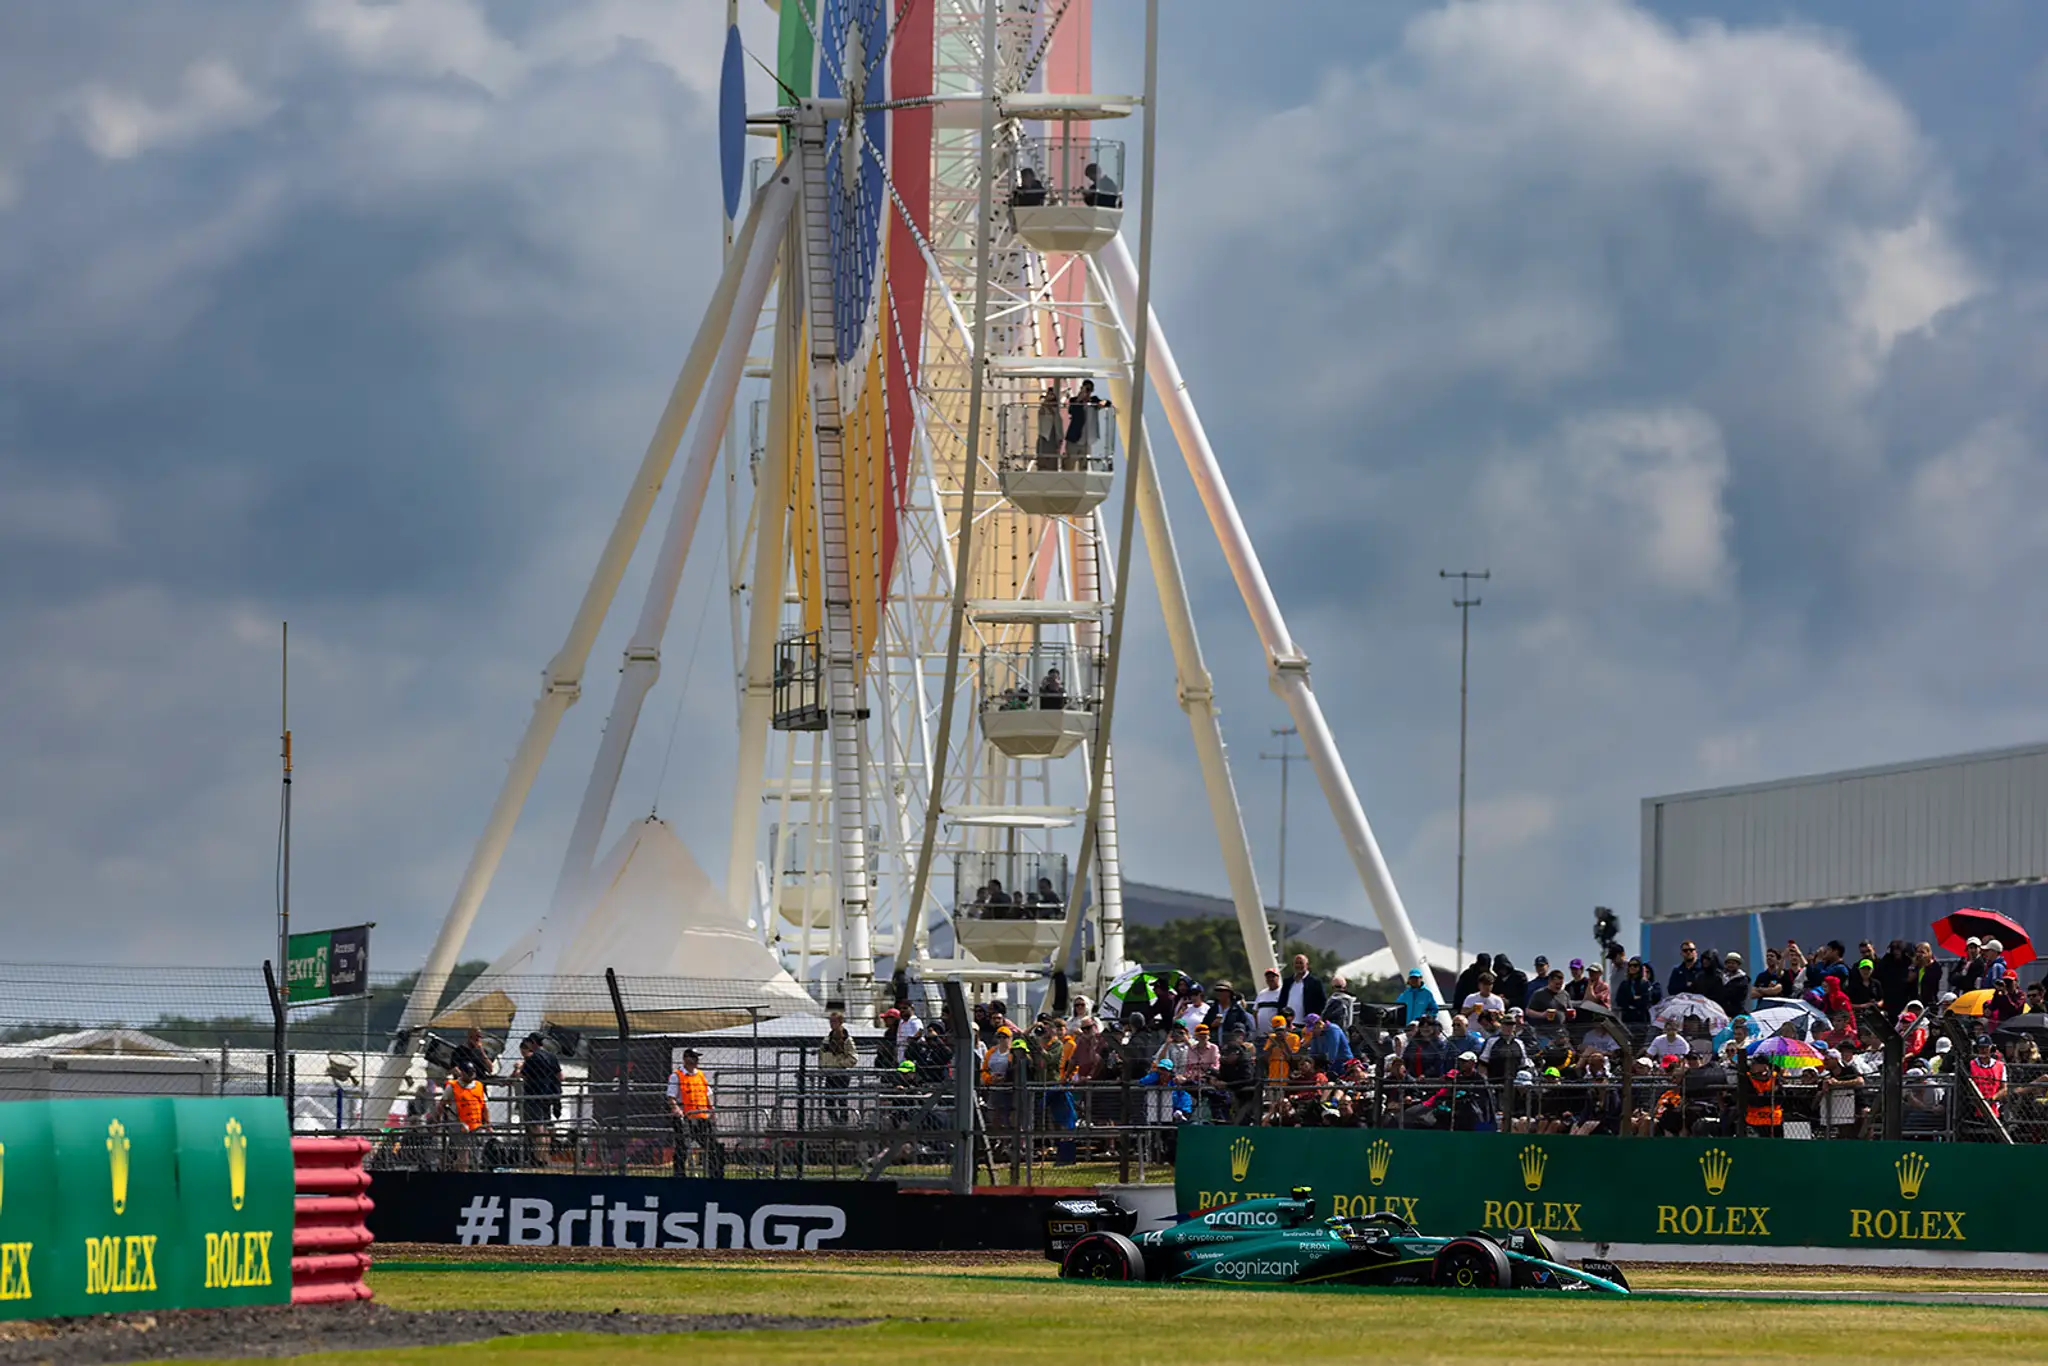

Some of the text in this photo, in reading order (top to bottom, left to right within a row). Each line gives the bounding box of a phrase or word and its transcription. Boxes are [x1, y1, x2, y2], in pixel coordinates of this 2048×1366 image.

[288, 957, 315, 981] EXIT
[456, 1195, 846, 1250] #BritishGP
[1052, 1223, 1087, 1233] JCB
[1203, 1211, 1279, 1226] aramco
[1482, 1200, 1582, 1232] ROLEX
[1656, 1205, 1771, 1236] ROLEX
[1849, 1209, 1967, 1240] ROLEX
[1143, 1230, 1164, 1247] 14
[1187, 1234, 1234, 1243] crypto.com
[1299, 1241, 1331, 1251] PERONI
[85, 1235, 158, 1295] ROLEX
[204, 1231, 273, 1289] ROLEX
[1214, 1258, 1300, 1280] cognizant
